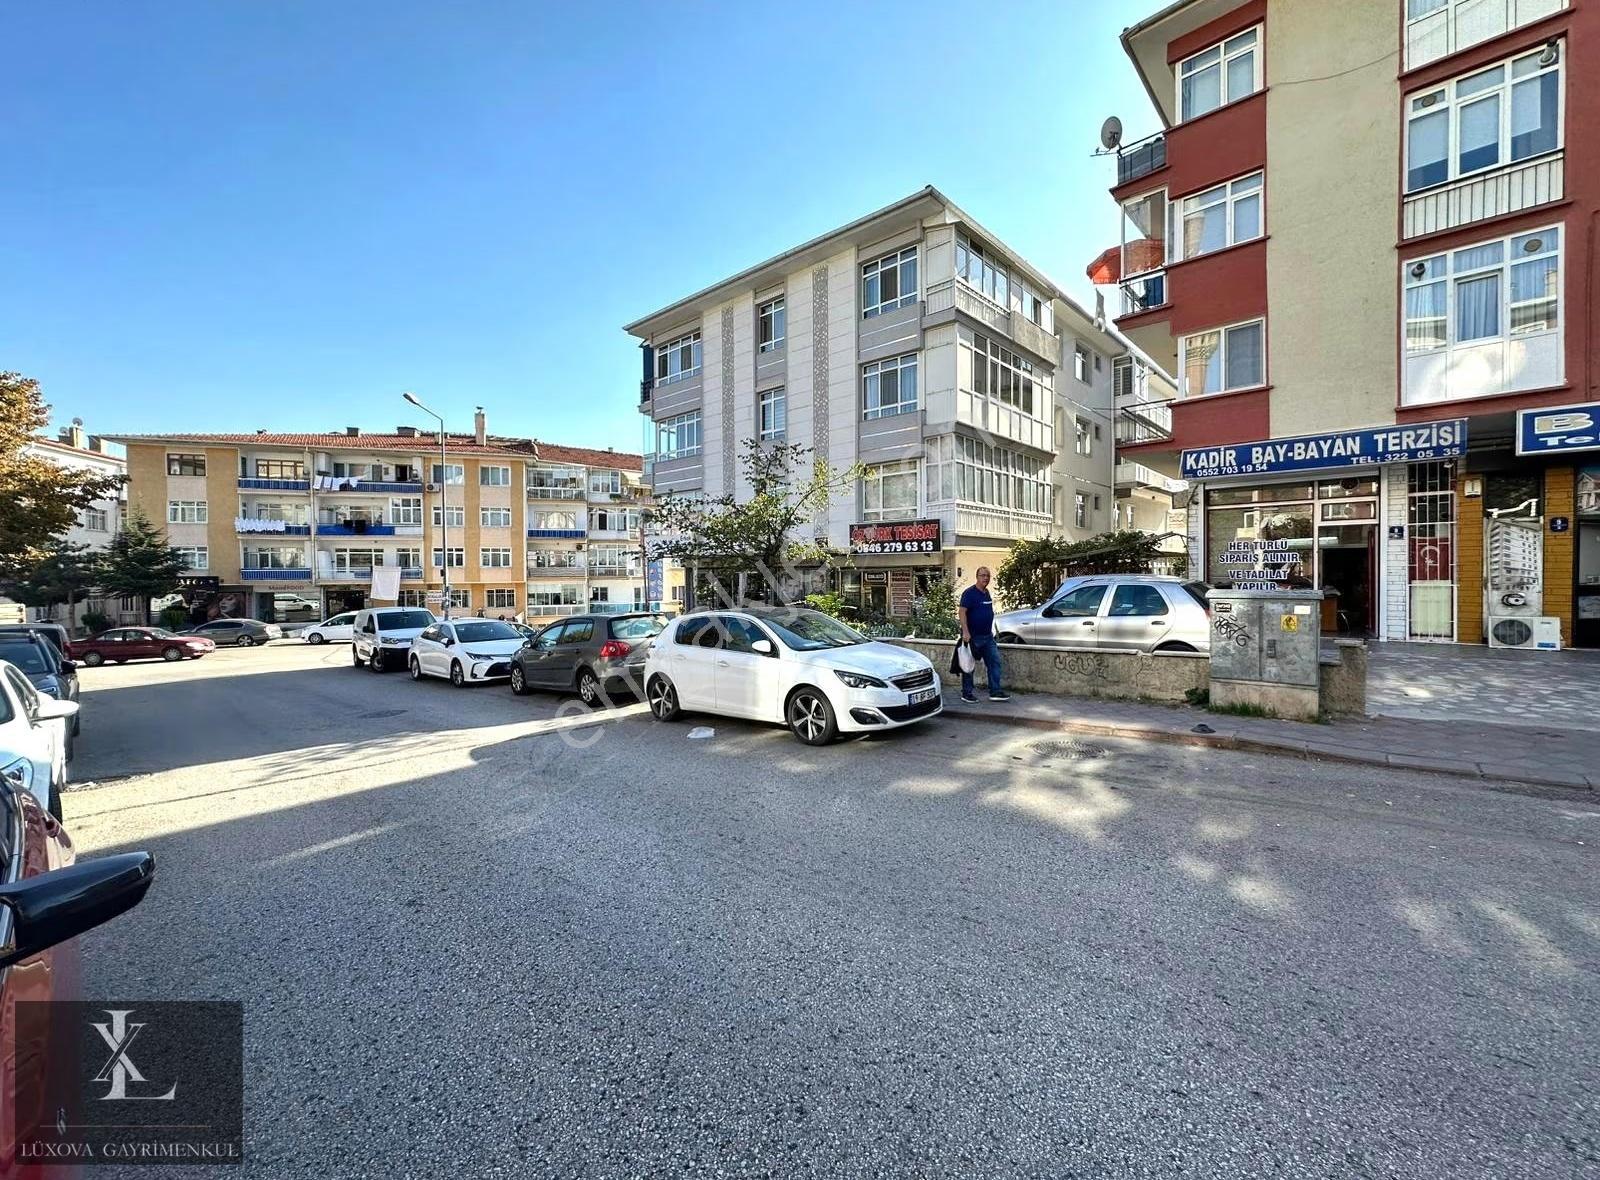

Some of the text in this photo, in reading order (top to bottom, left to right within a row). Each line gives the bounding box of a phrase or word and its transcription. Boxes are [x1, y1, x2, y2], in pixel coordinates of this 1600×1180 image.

[1186, 421, 1460, 470] KADİR BAY-BAYAN TERZİSİ
[1384, 452, 1409, 462] 322
[1416, 449, 1434, 459] 05
[1442, 447, 1460, 456] 35
[1196, 463, 1267, 477] 0552 703 19 54
[883, 541, 903, 552] 279
[904, 541, 919, 552] 63
[920, 540, 934, 552] 13
[1229, 541, 1250, 551] HER
[1229, 570, 1242, 579] VE
